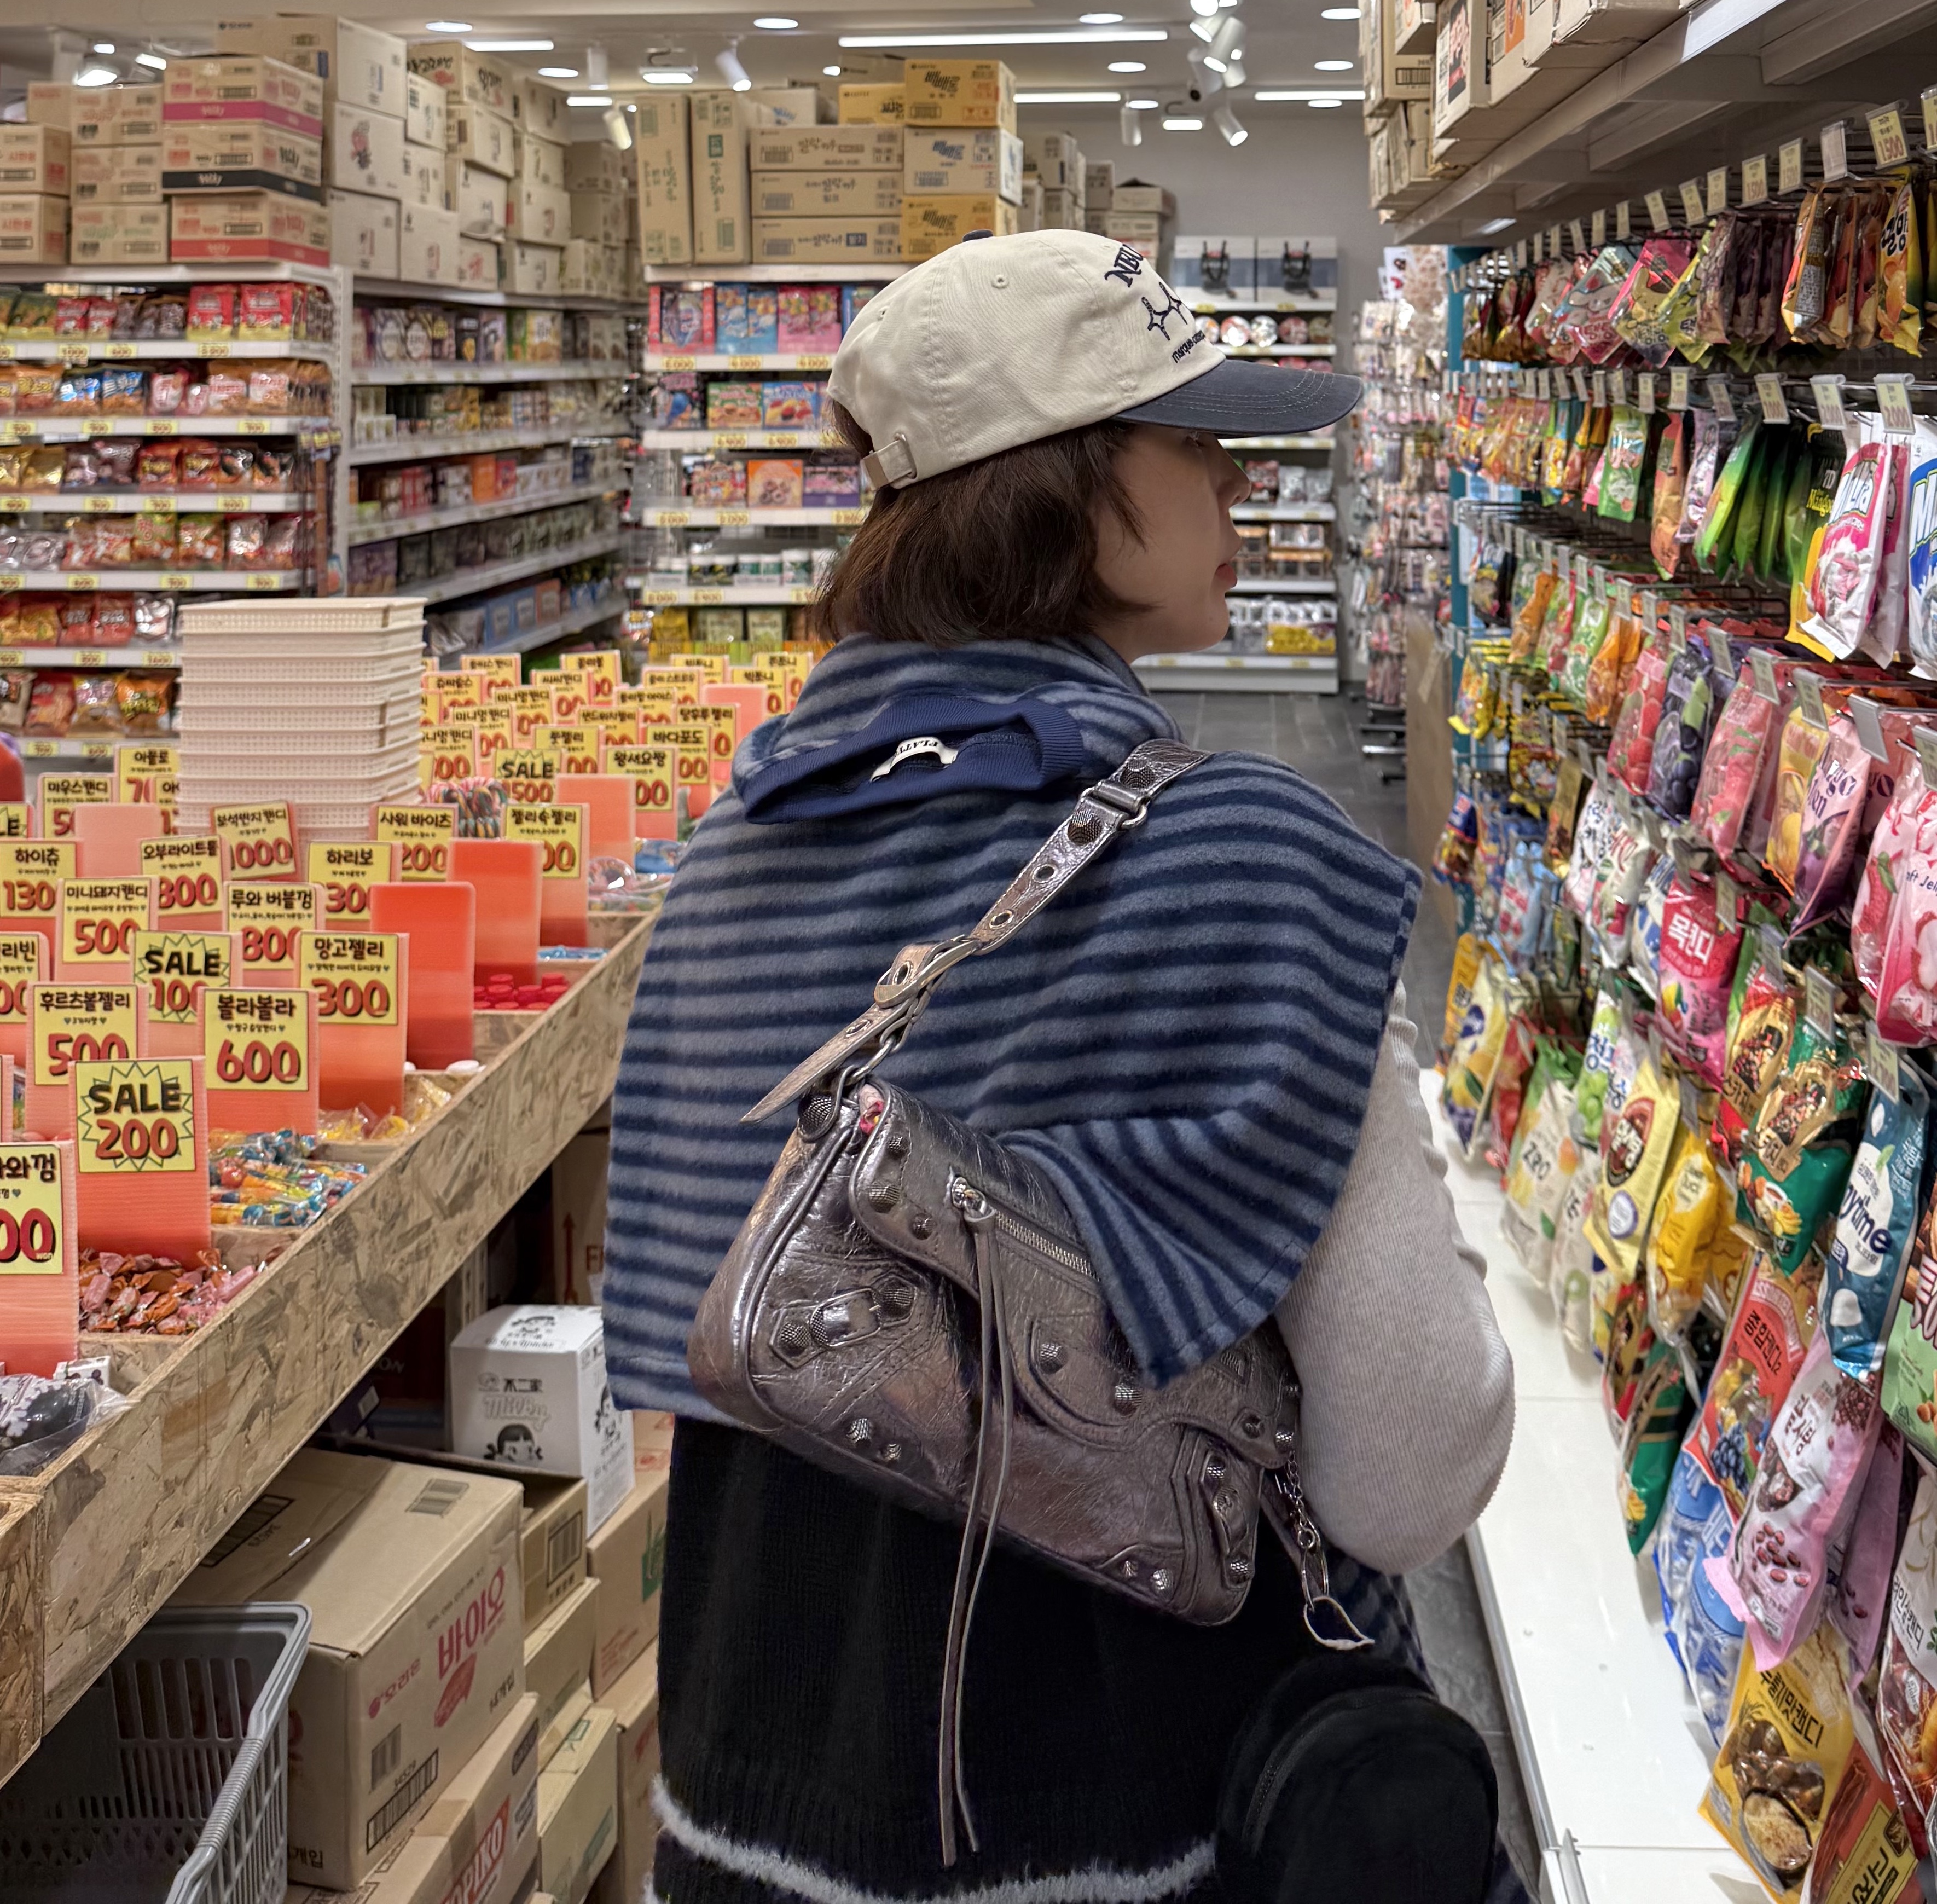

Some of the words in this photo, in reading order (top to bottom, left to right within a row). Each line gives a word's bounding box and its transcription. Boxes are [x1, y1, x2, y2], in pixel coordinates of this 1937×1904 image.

[501, 760, 554, 778] SALE
[15, 848, 60, 866] 하이츄
[327, 848, 374, 865] 하리보
[3, 880, 55, 911] 130
[266, 888, 313, 910] 버블껌
[314, 937, 384, 960] 망고젤리
[144, 950, 220, 976] SALE
[40, 991, 130, 1012] 후르츠볼젤리
[217, 994, 297, 1021] 볼라볼라
[216, 1038, 301, 1084] 600
[88, 1083, 181, 1115] SALE
[95, 1118, 179, 1159] 200
[437, 1565, 506, 1681] 바이오
